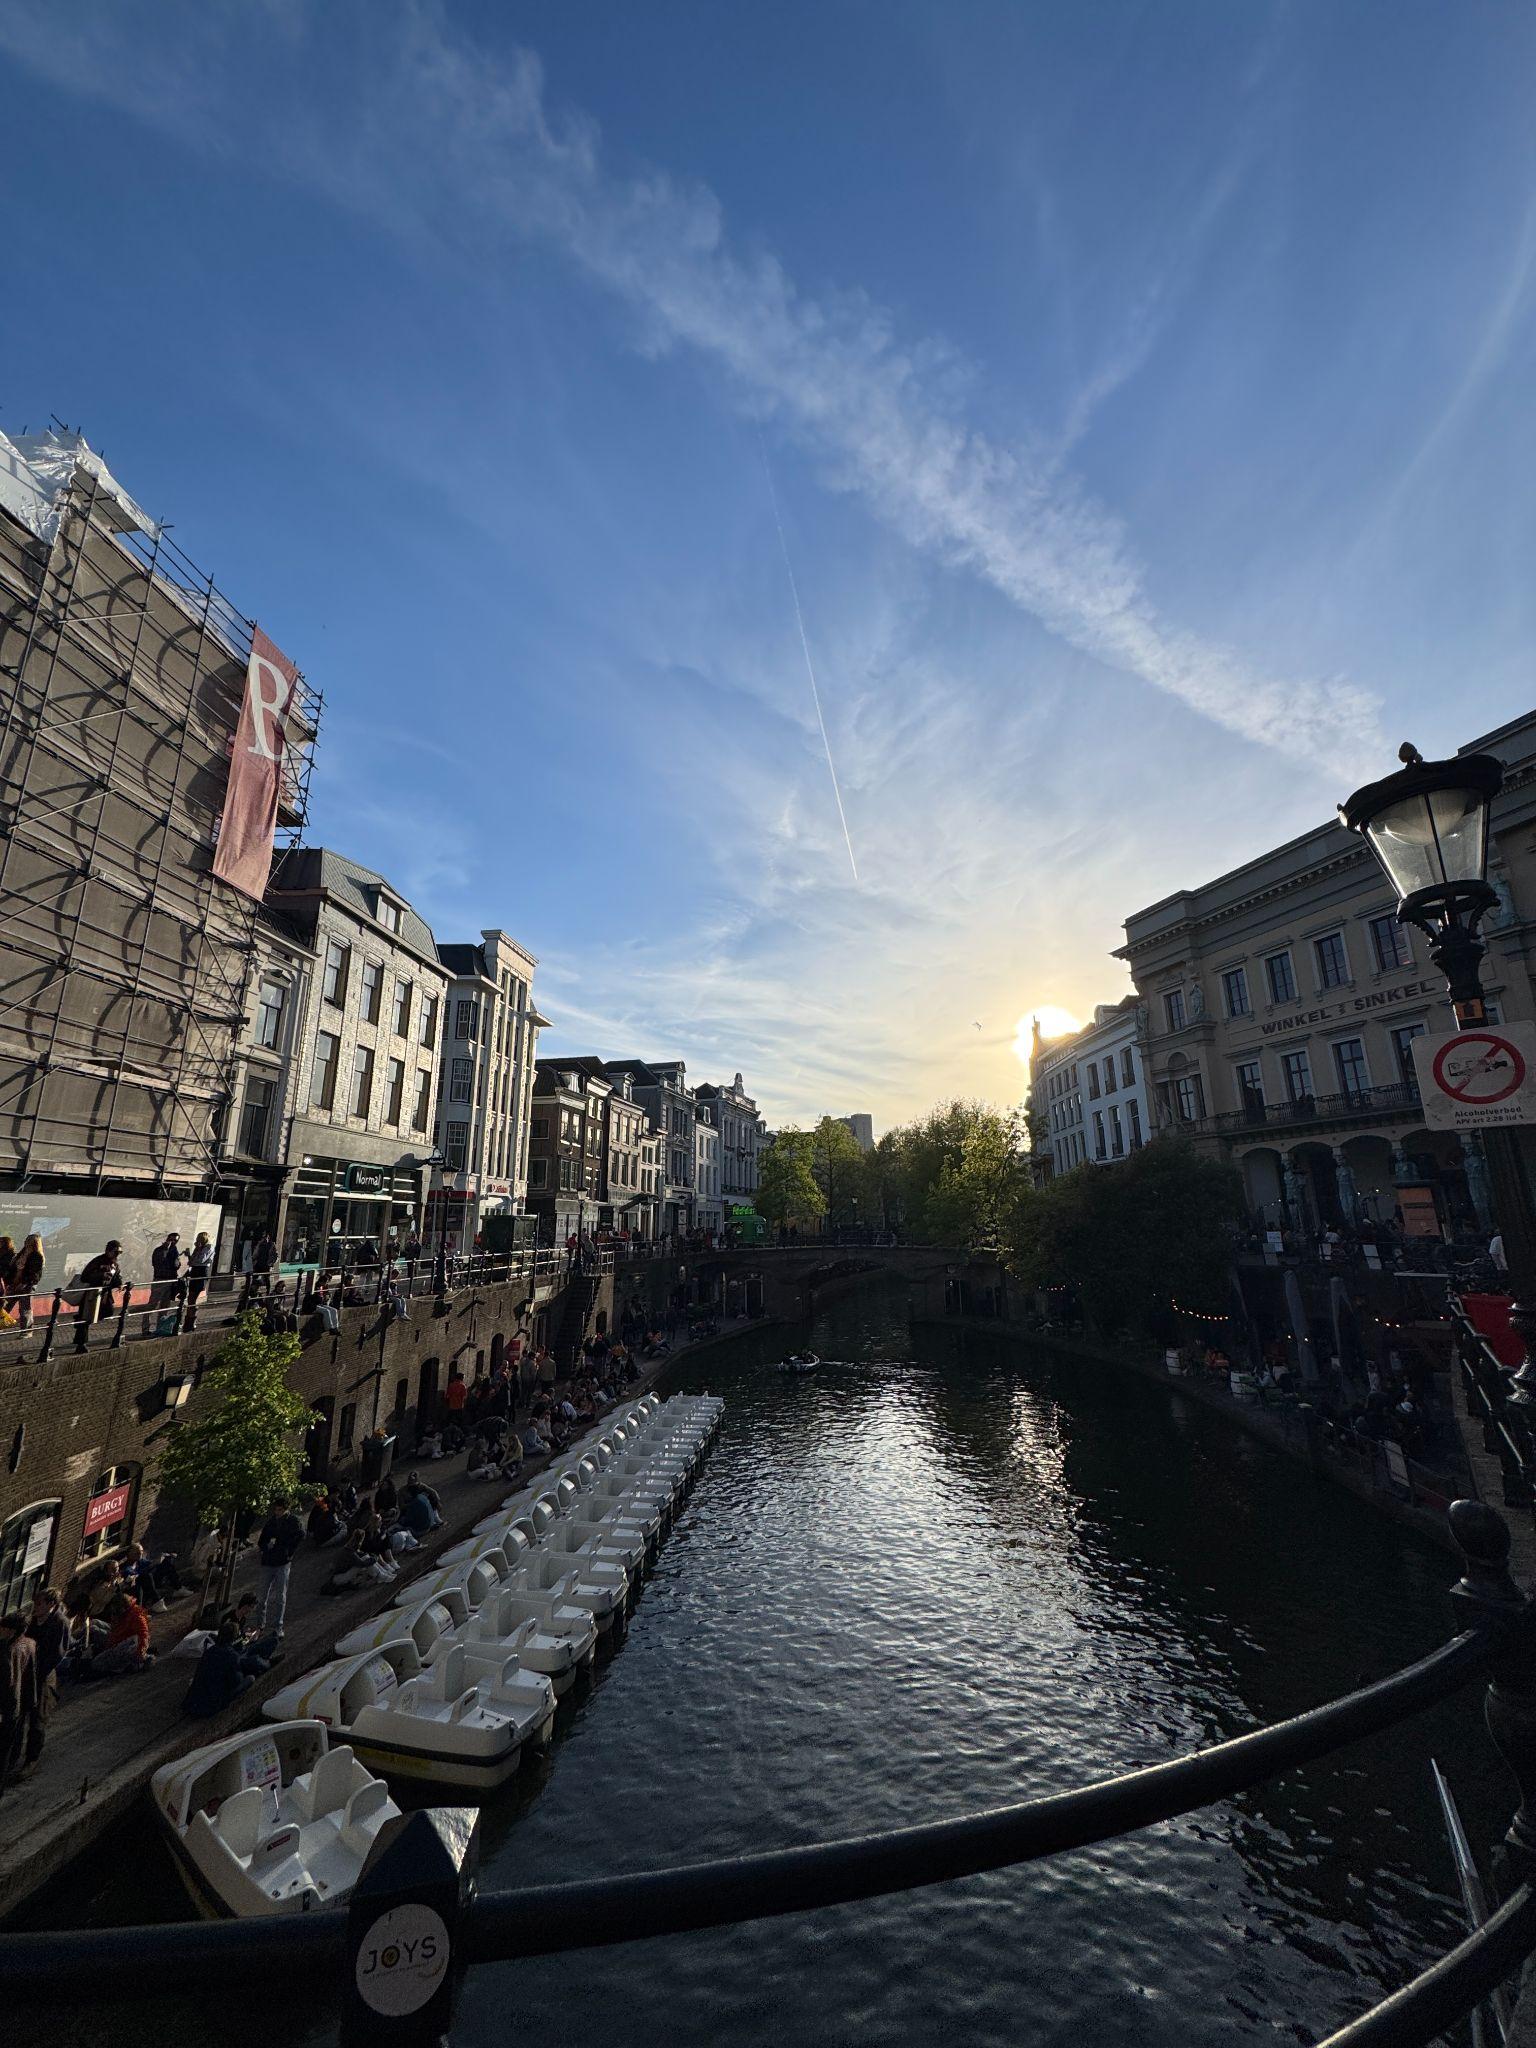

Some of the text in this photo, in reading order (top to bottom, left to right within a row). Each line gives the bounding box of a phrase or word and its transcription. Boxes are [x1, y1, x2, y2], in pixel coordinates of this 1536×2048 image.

[1261, 1010, 1332, 1034] WINKEL
[1354, 982, 1436, 1010] SINKEL
[1455, 1106, 1522, 1118] Alcoholverbod
[355, 1169, 382, 1186] Normal
[91, 1495, 125, 1519] BURGY
[363, 1936, 437, 1975] JOYS
